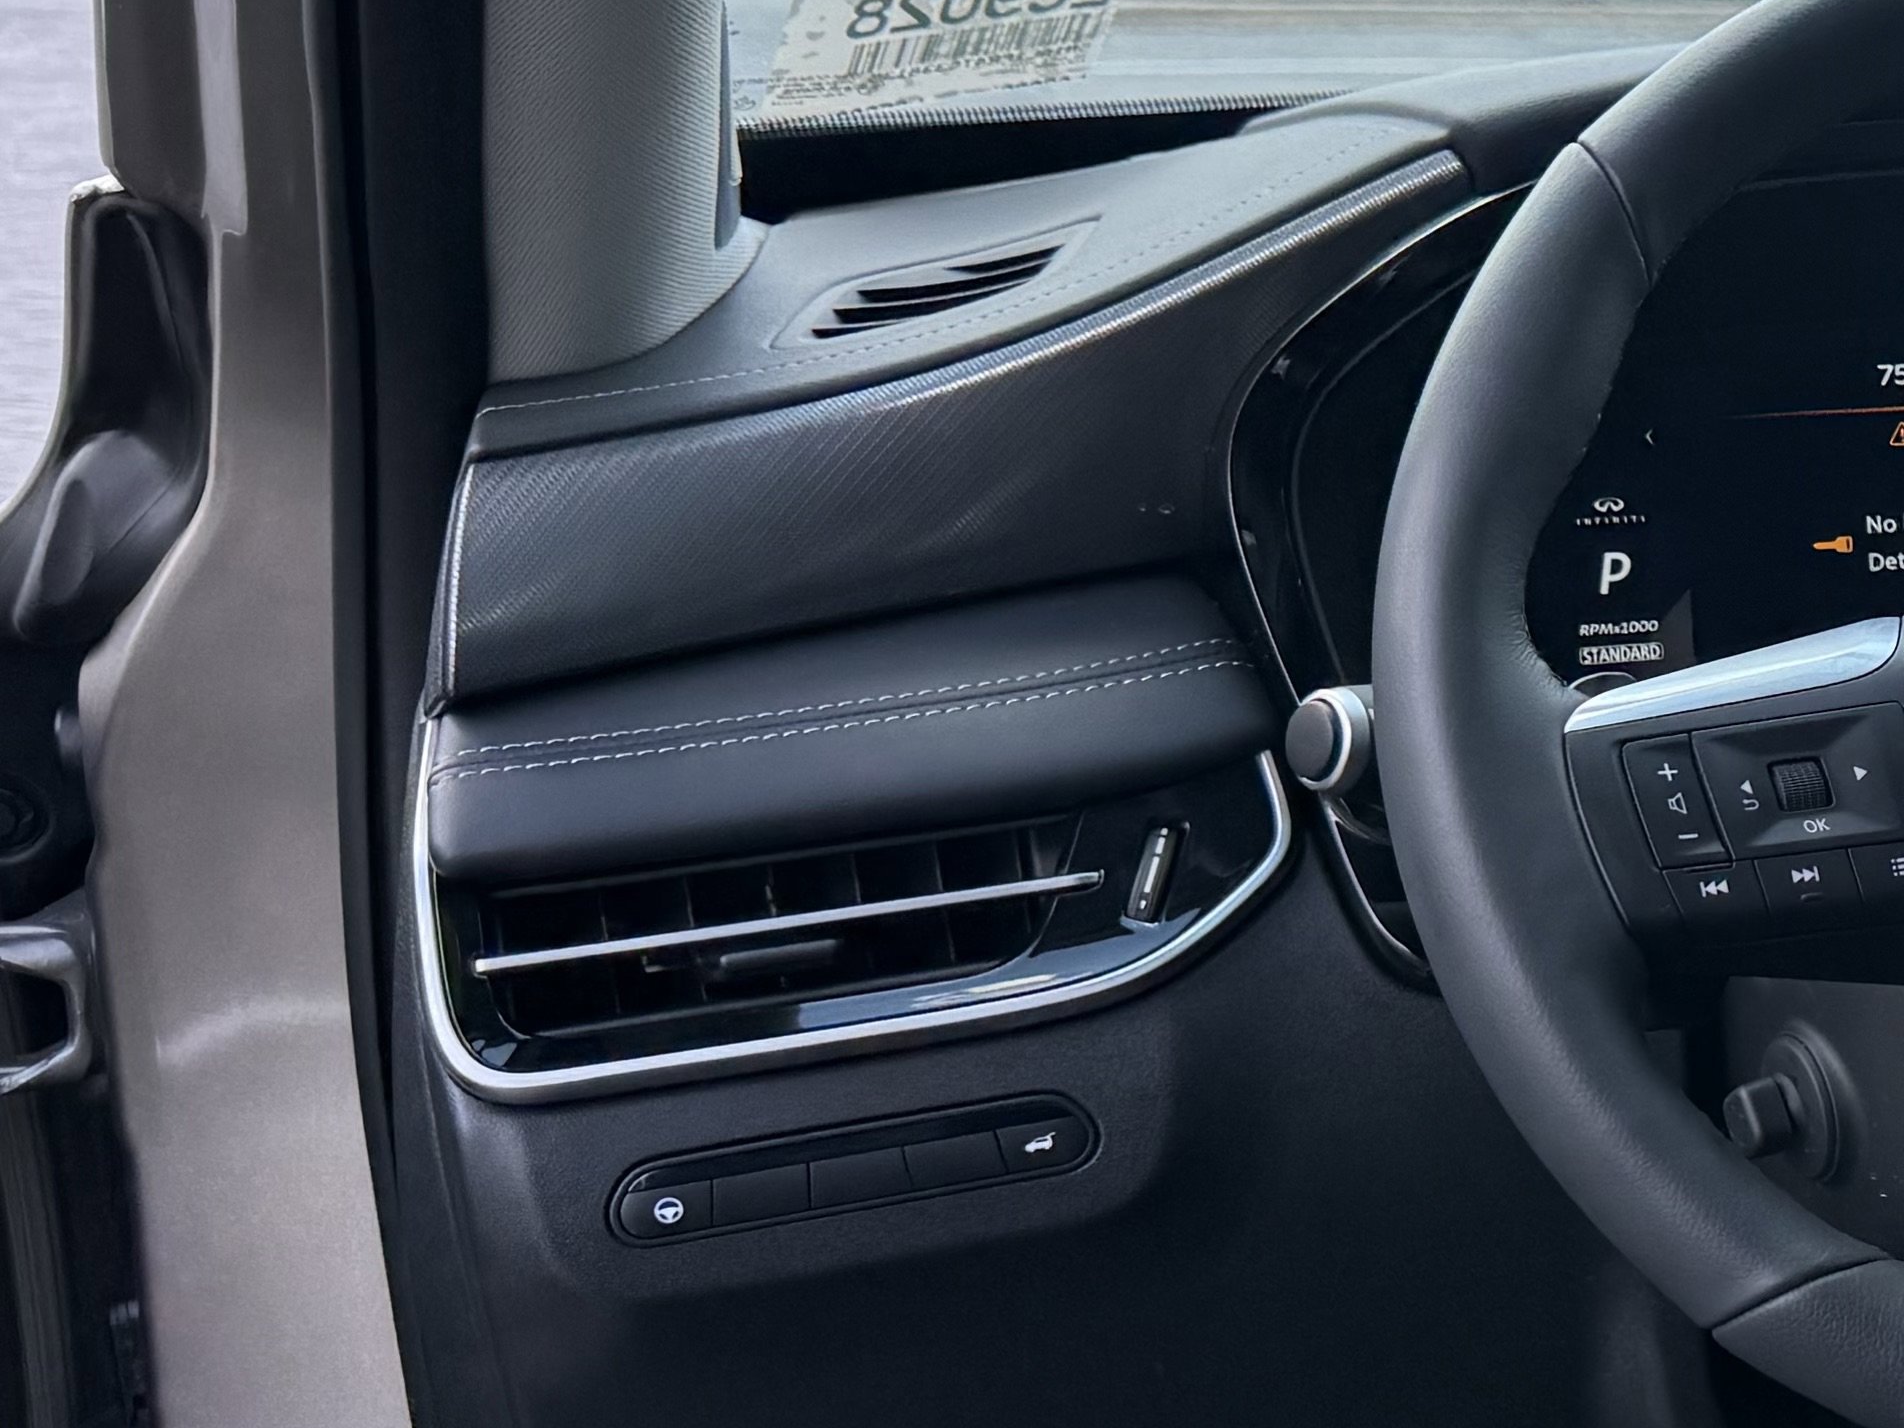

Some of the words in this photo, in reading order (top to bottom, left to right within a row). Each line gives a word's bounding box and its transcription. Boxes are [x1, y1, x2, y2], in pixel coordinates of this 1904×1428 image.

[1866, 515, 1897, 535] No
[1599, 551, 1632, 595] P
[1581, 643, 1662, 665] STANDARD
[1803, 817, 1831, 833] OK
